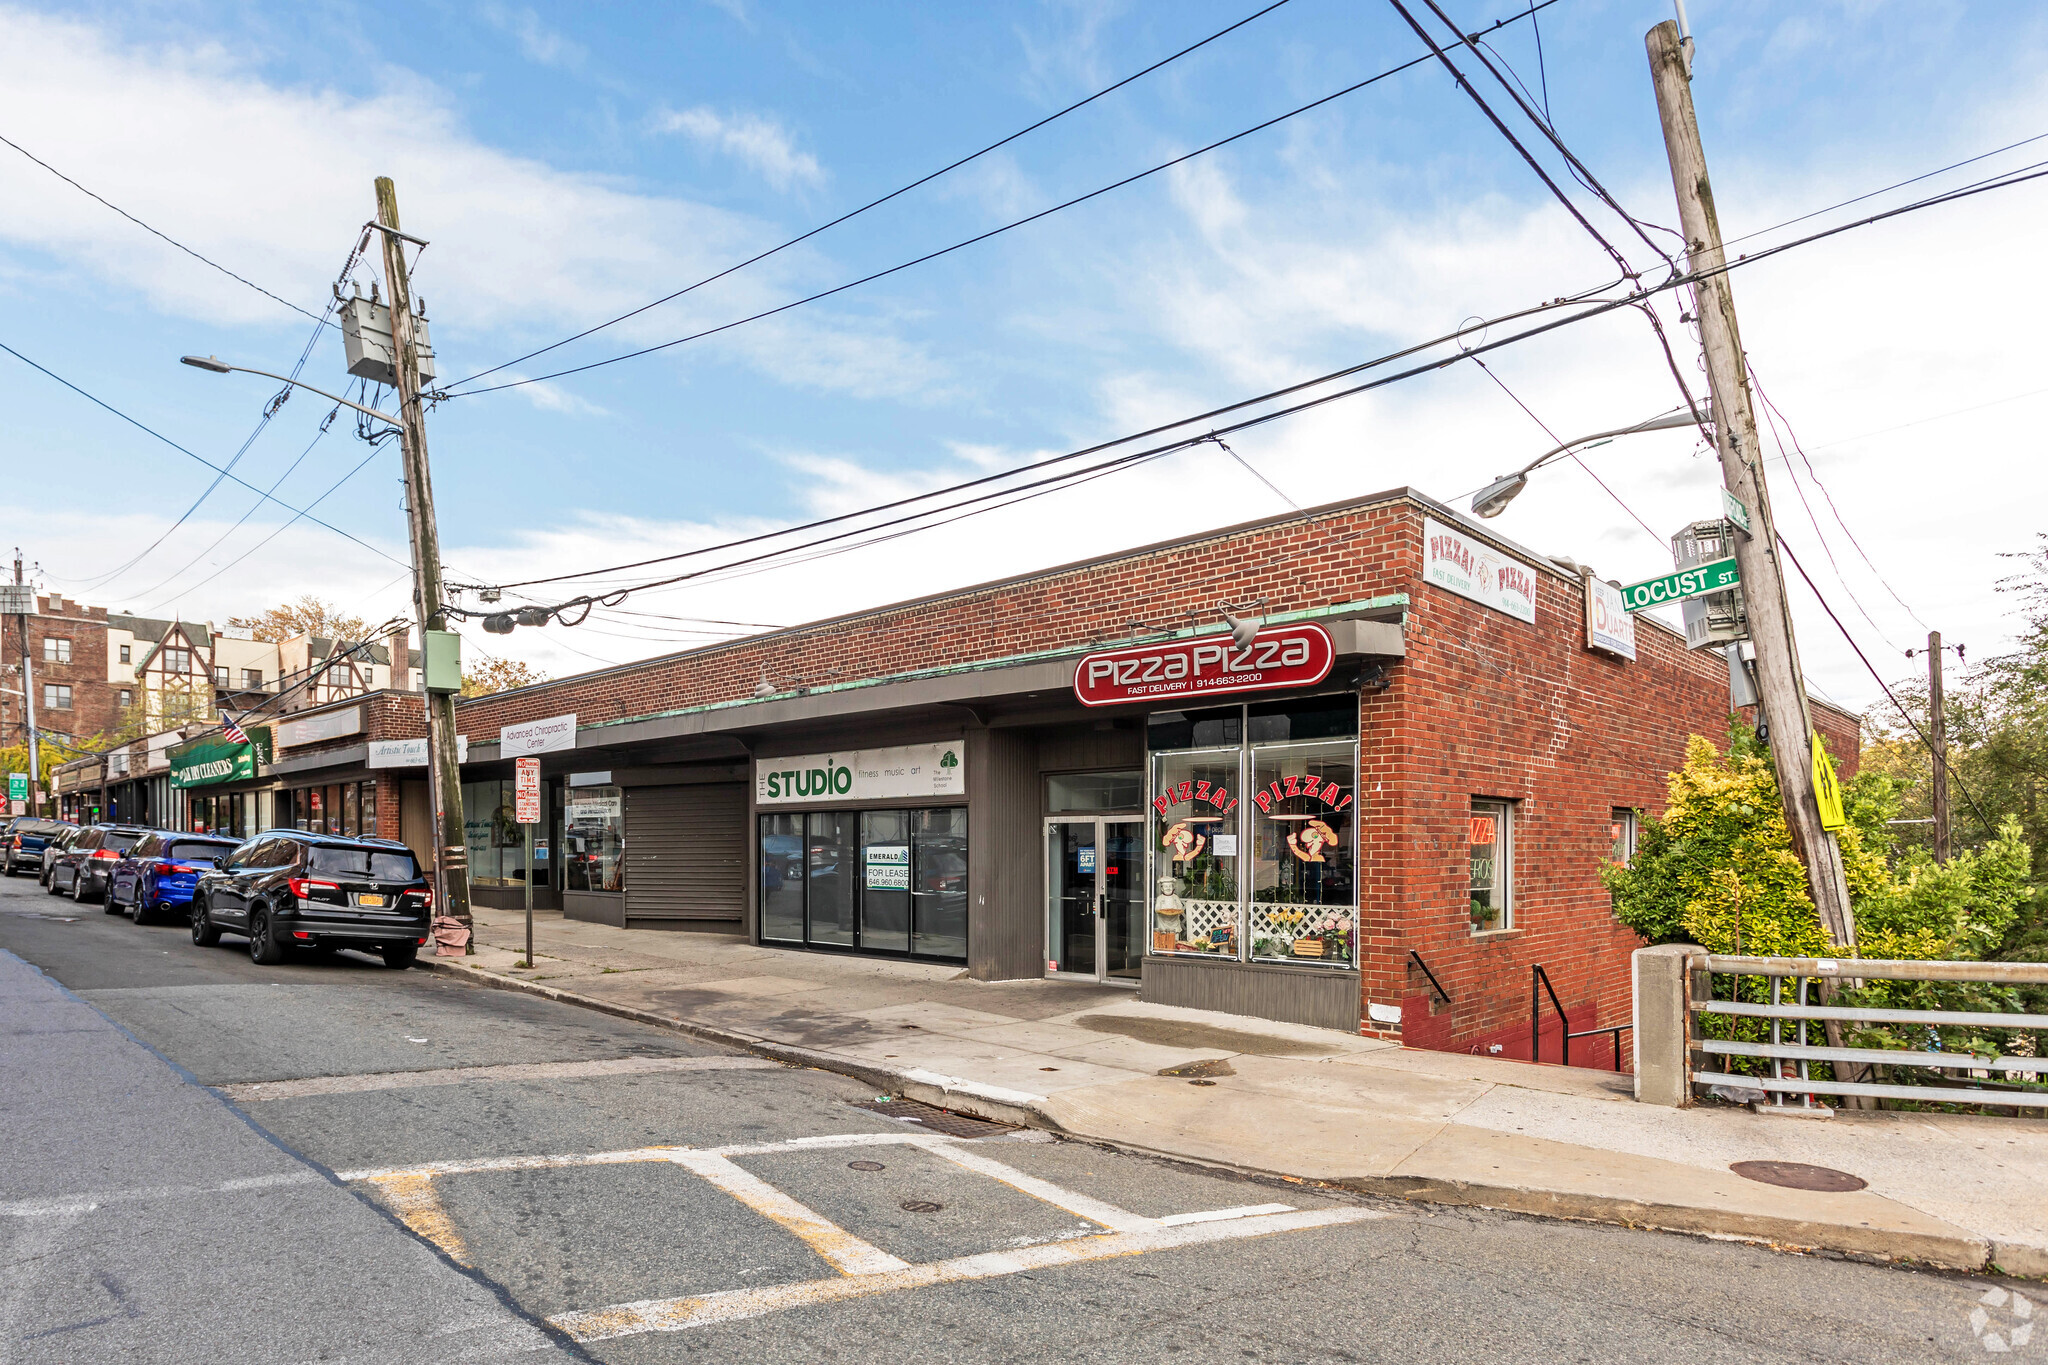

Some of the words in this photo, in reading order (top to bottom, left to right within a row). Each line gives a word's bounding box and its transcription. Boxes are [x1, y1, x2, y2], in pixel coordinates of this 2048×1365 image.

[1430, 535, 1475, 578] PIZZA!
[1432, 567, 1446, 582] FAST
[1446, 573, 1472, 592] DELIVERY
[1498, 566, 1534, 605] PIZZA!
[1622, 569, 1708, 610] LOCUST
[1718, 571, 1734, 584] ST
[1595, 595, 1635, 645] DUARTE
[1128, 685, 1147, 695] FAST
[1149, 681, 1187, 693] DELIVERY
[1196, 673, 1262, 688] 914-663-2200
[506, 728, 533, 741] Advanced
[534, 722, 568, 736] Chiropractic
[402, 743, 420, 754] Touch
[526, 738, 545, 749] Center
[200, 758, 233, 779] CLEANERS
[517, 760, 526, 768] NO
[858, 769, 879, 778] fitness
[884, 768, 905, 777] music
[910, 765, 921, 775] art
[758, 772, 766, 798] THE
[1254, 774, 1353, 813] PIZZA!
[1153, 780, 1239, 816] PIZZA!
[1470, 816, 1496, 845] IZZA
[1080, 854, 1095, 863] 6FT
[1470, 858, 1495, 879] EROS
[868, 868, 884, 877] FOR
[884, 869, 909, 878] LEASE
[868, 878, 909, 887] 646.960.6800
